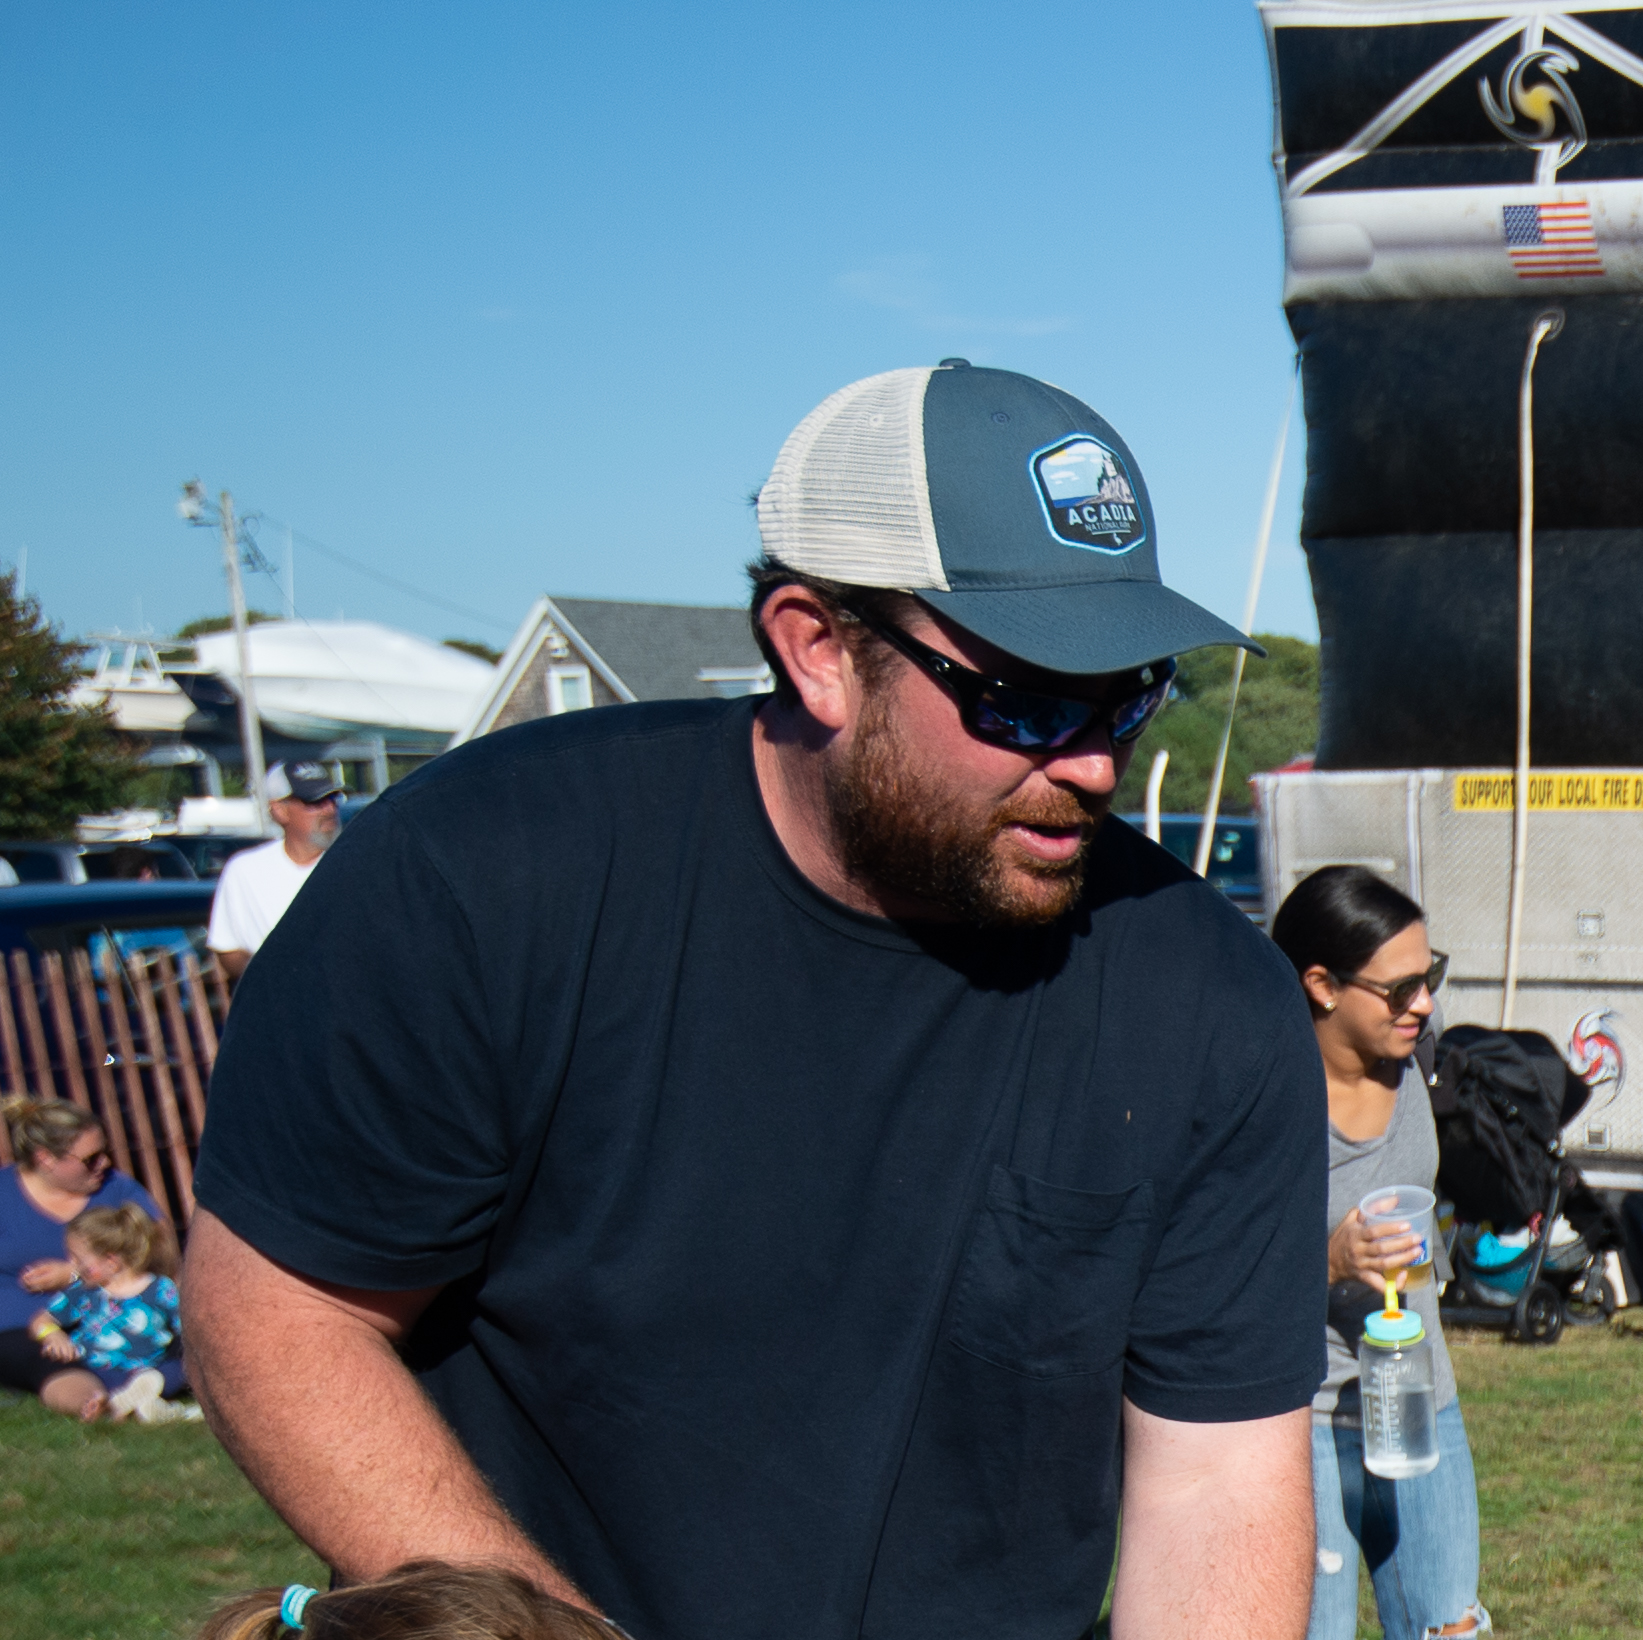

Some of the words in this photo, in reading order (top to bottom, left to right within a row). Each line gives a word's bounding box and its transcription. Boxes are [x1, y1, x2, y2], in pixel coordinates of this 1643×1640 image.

[1068, 504, 1137, 526] ACADIA
[1559, 778, 1597, 805] LOCAL
[1603, 778, 1629, 805] FIRE
